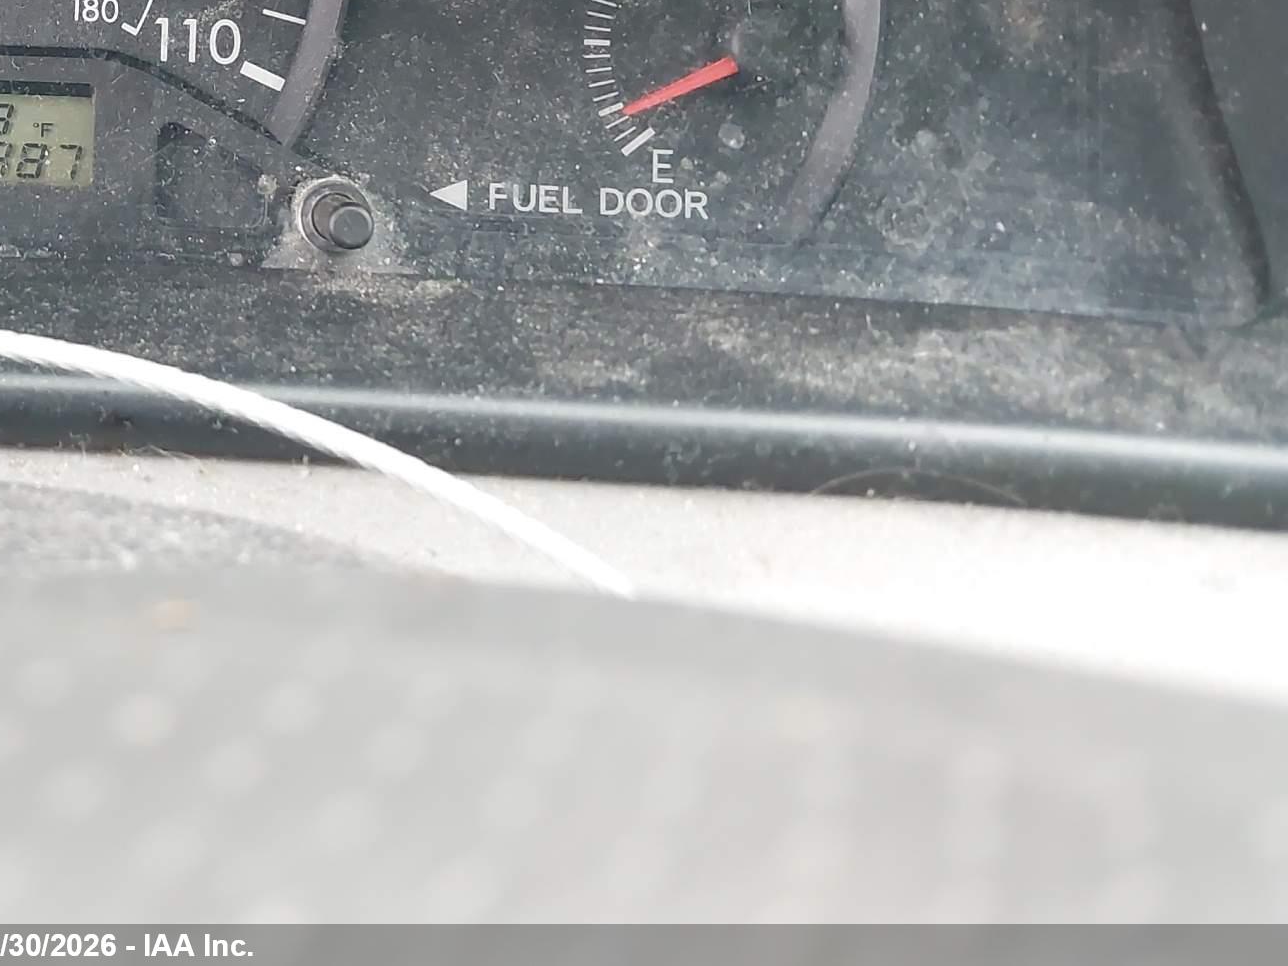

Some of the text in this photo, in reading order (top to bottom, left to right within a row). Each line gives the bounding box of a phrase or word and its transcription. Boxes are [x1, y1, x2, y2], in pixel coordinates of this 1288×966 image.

[157, 18, 241, 64] 110
[653, 149, 674, 183] E
[489, 183, 709, 219] FUEL DOOR
